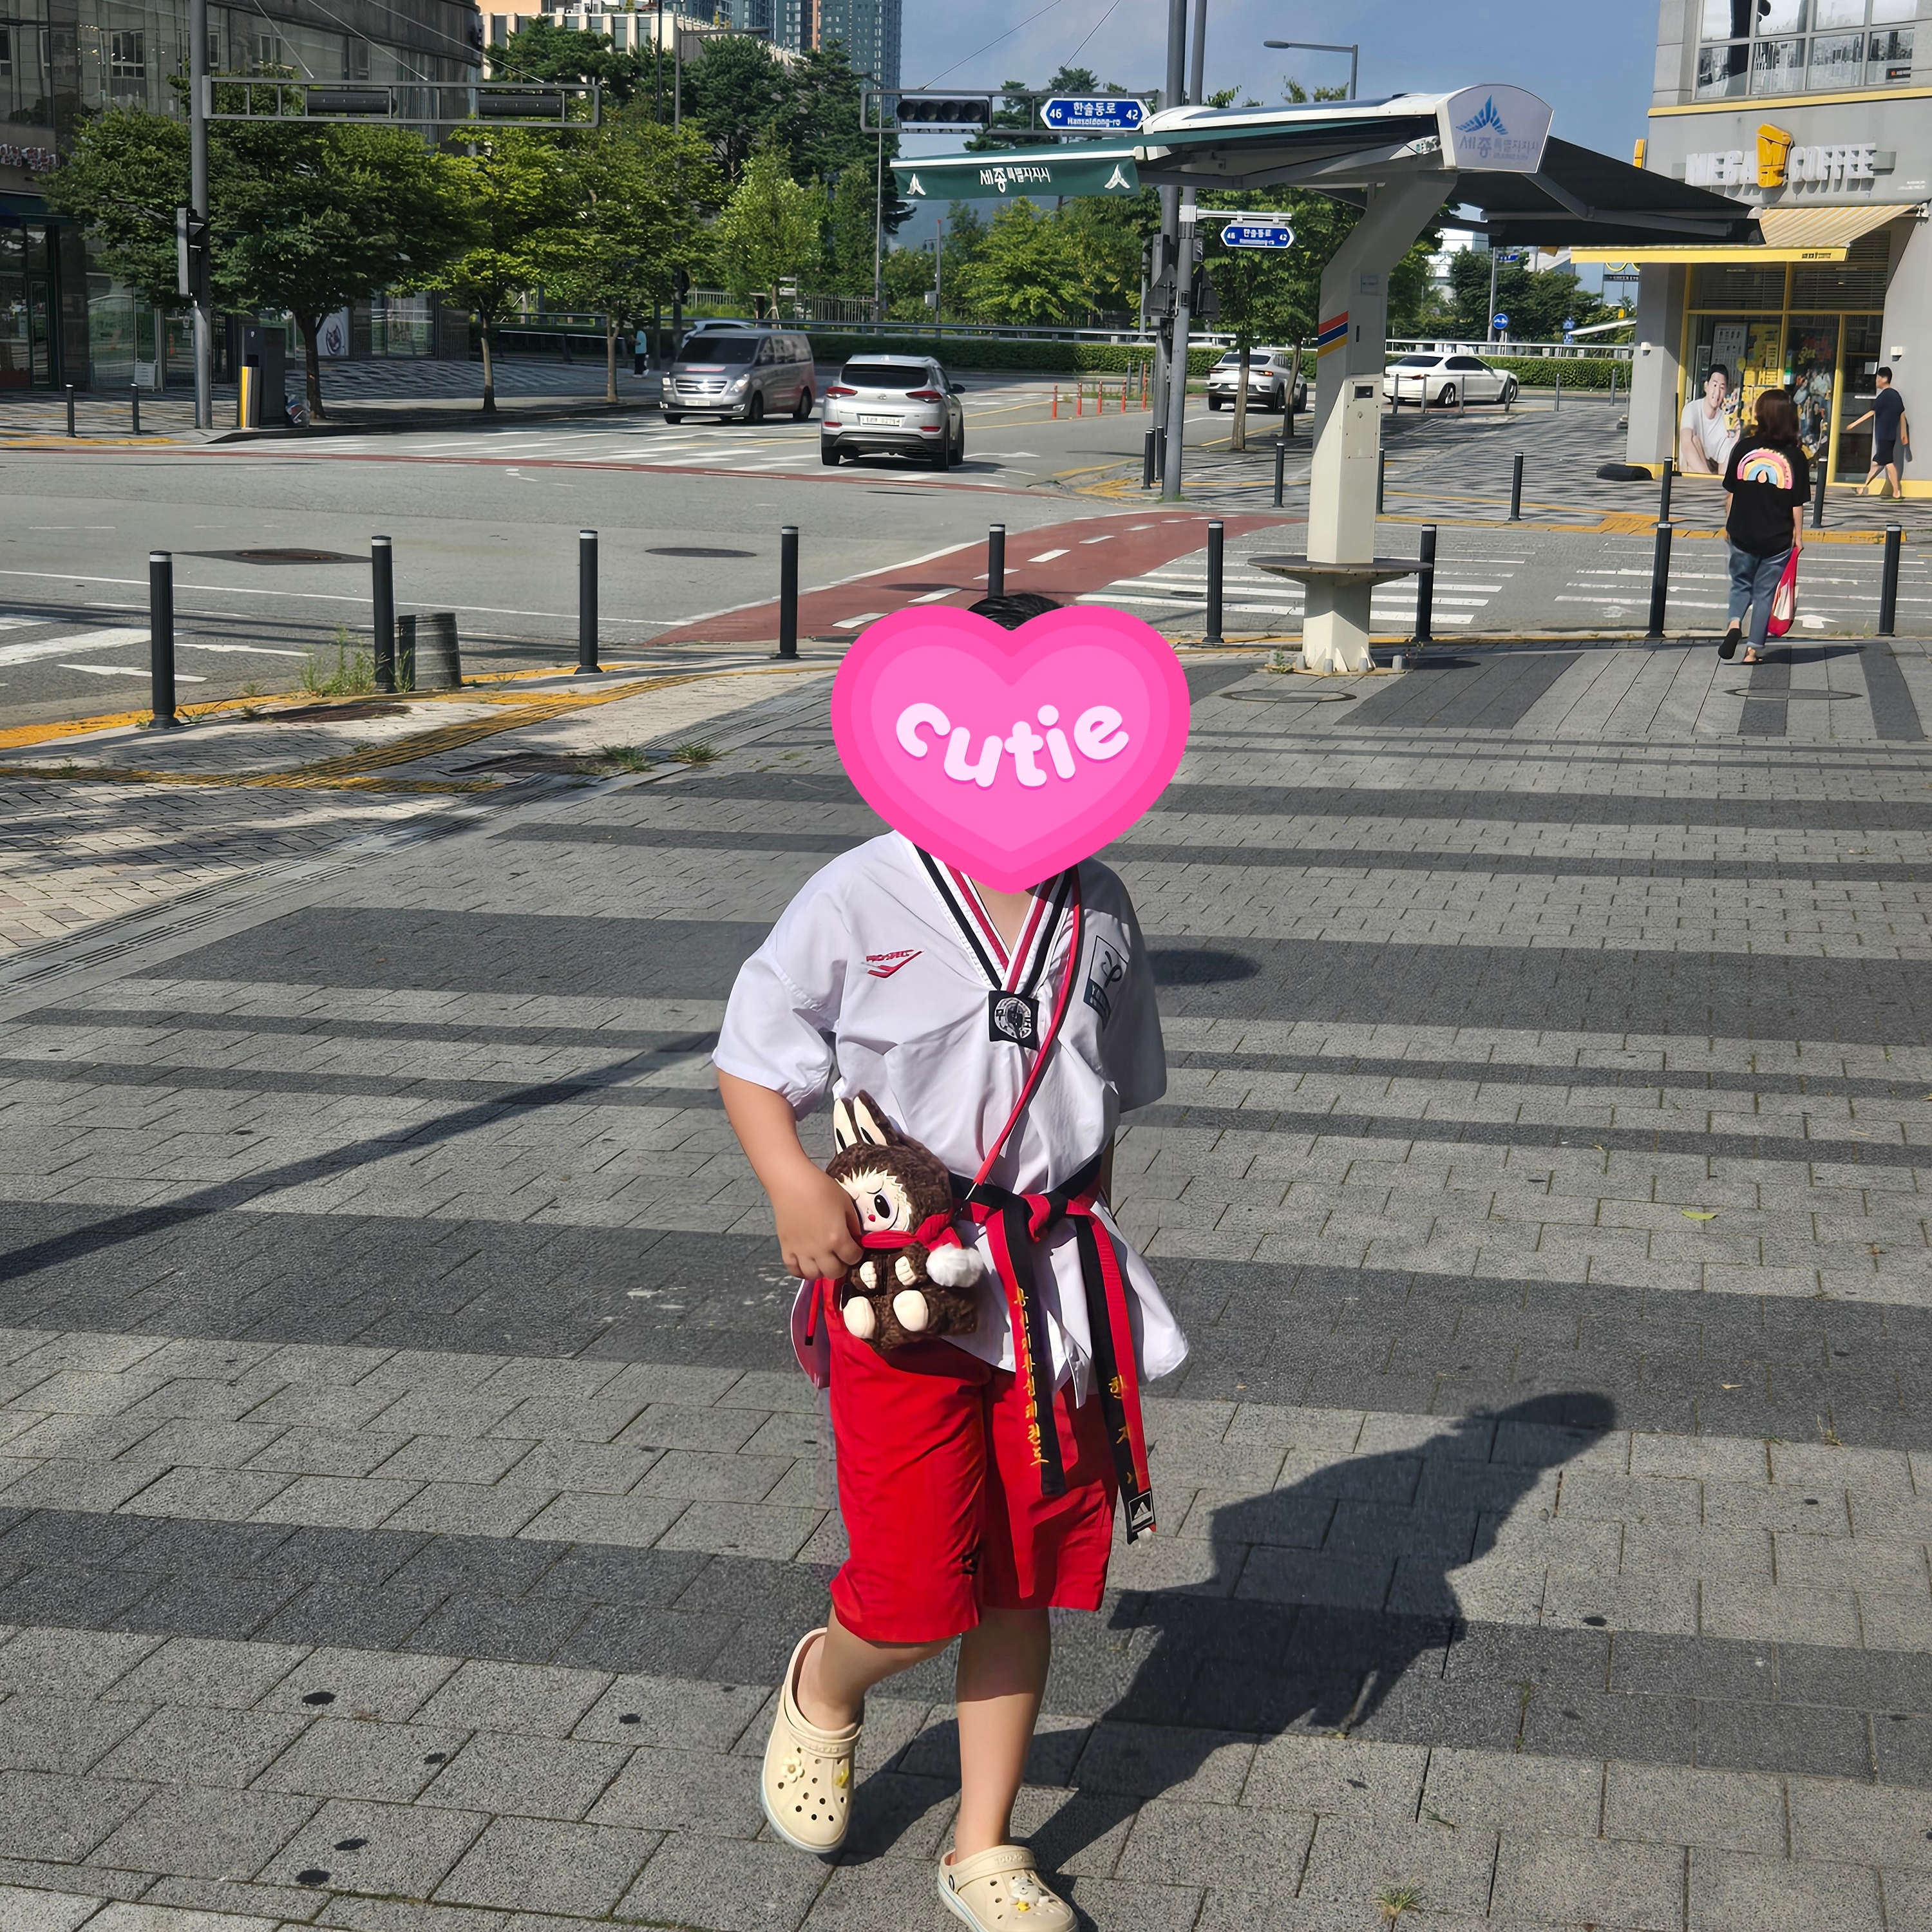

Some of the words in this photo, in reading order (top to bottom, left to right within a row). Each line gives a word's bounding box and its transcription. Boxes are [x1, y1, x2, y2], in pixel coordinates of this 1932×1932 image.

[1049, 108, 1063, 119] 46
[1074, 102, 1117, 117] 한솔동로
[1126, 109, 1139, 120] 42
[1067, 117, 1121, 128] Hansoldong-ro
[1685, 149, 1758, 187] MEGA
[1788, 142, 1877, 182] COFFEE
